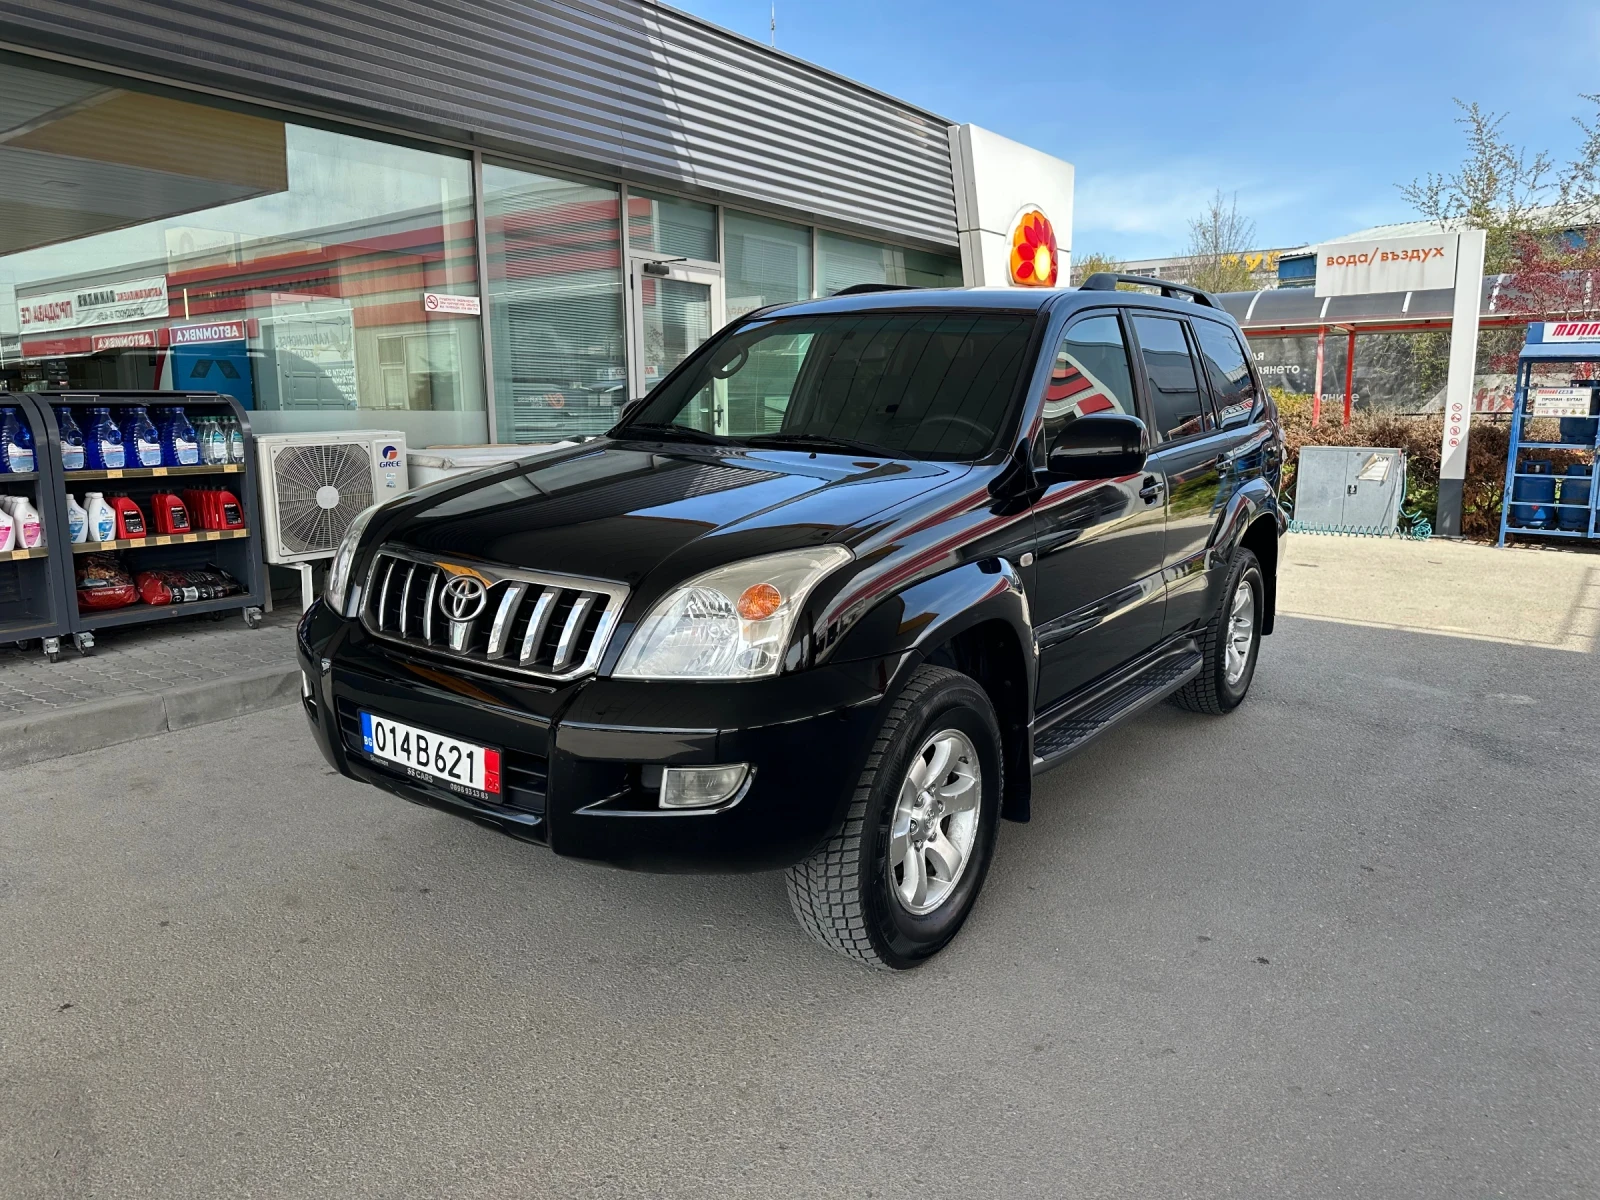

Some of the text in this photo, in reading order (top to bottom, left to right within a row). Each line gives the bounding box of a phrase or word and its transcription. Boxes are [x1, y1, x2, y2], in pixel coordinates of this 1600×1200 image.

[379, 460, 402, 468] GREE
[364, 736, 373, 746] BG
[375, 721, 474, 783] 014B621
[416, 771, 434, 783] CARS
